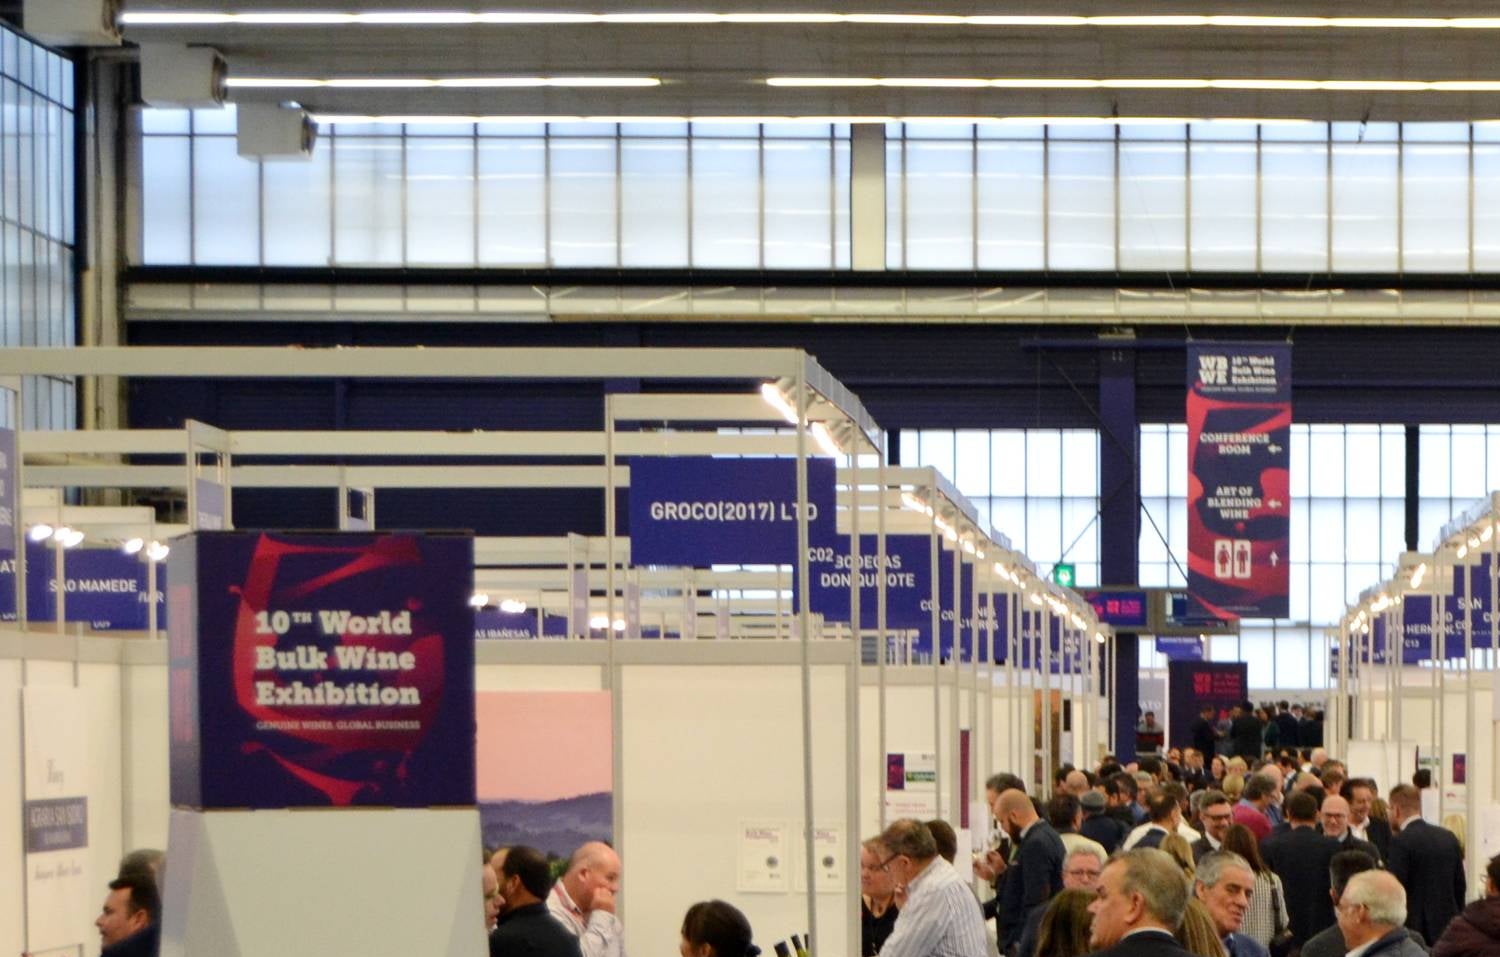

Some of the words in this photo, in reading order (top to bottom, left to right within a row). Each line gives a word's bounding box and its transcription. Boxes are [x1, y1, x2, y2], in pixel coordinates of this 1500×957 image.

[1200, 433, 1269, 443] CONFERENCE
[1219, 444, 1250, 454] ROOM
[1216, 486, 1237, 496] ART
[1239, 486, 1253, 496] OF
[1208, 498, 1262, 507] BLENDING
[651, 501, 775, 522] GROCO(2017)
[1220, 509, 1249, 519] WINE
[808, 548, 834, 562] C02
[80, 579, 137, 593] MAMEDE
[821, 573, 850, 587] DON
[858, 573, 915, 587] QUIOTE
[256, 610, 313, 635] 10TH
[319, 610, 412, 635] World
[255, 646, 328, 670] Bulk
[334, 646, 416, 670] Wine
[255, 681, 421, 706] Exhibition
[336, 720, 374, 730] GLOBAL
